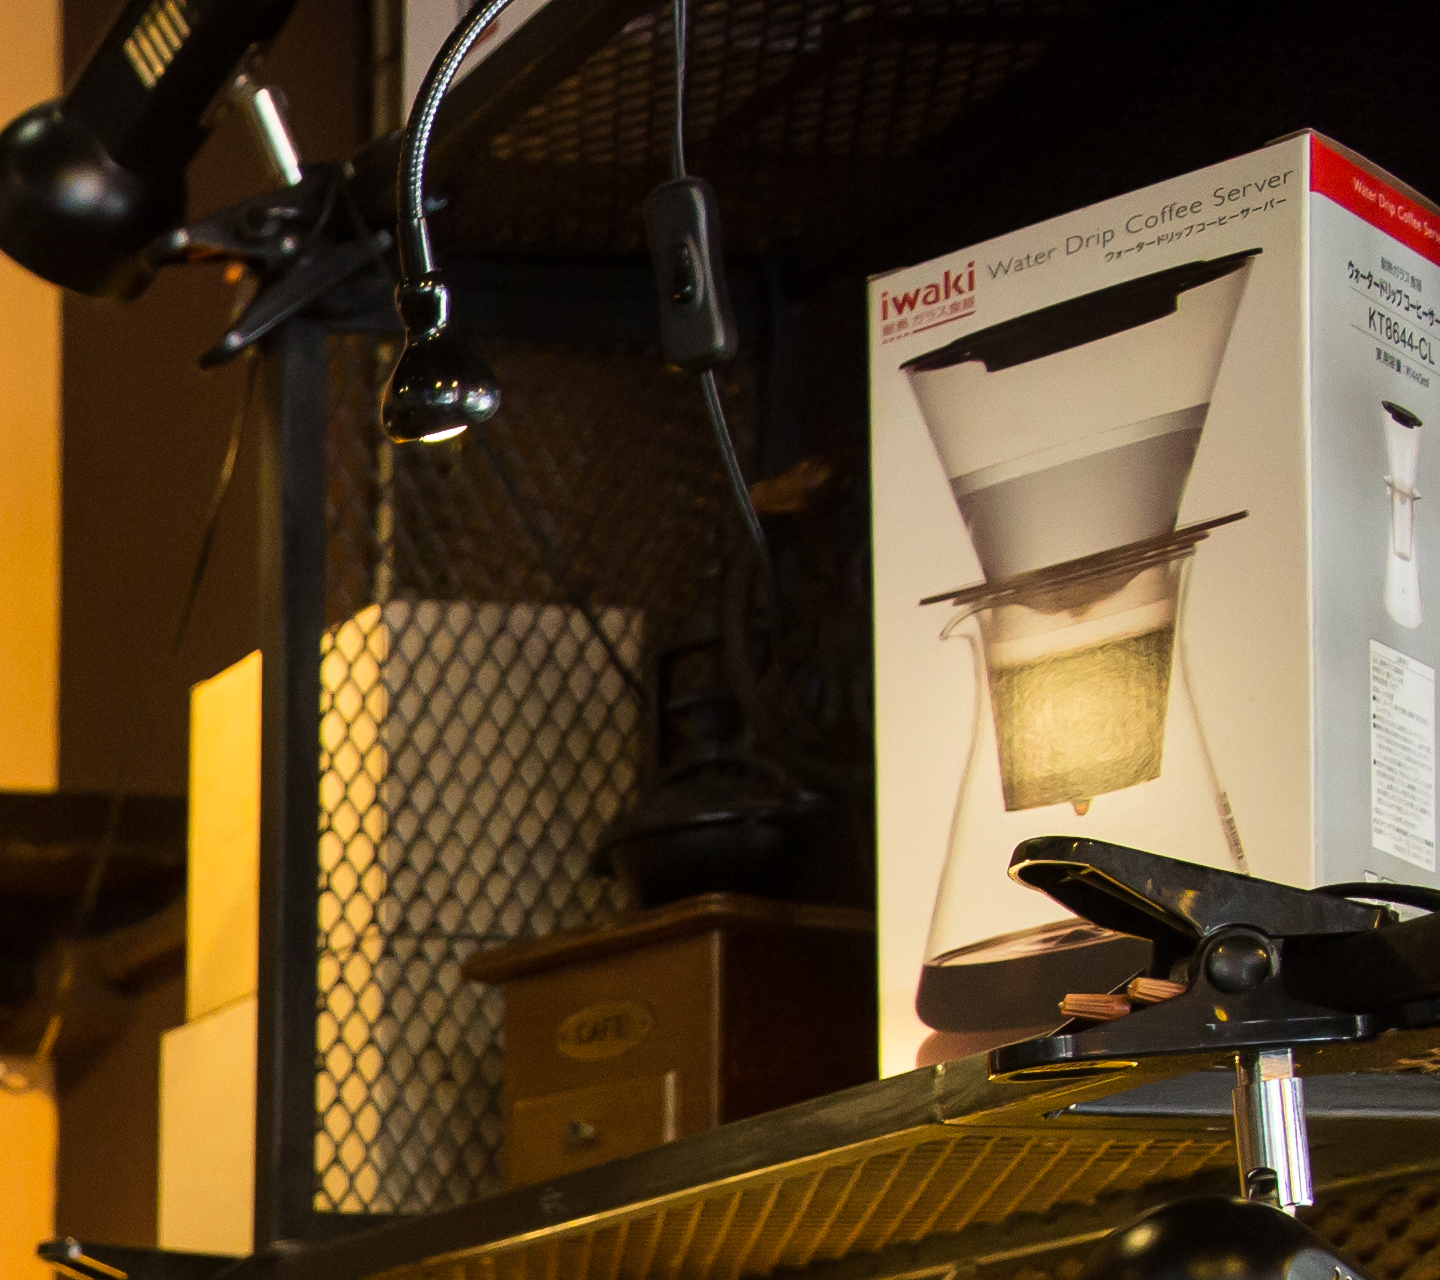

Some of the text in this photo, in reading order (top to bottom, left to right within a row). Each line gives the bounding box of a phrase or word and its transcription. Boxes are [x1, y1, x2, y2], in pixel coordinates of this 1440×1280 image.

[988, 169, 1294, 280] Water Drip Coffee Server
[881, 260, 975, 321] iwaki
[1368, 306, 1435, 366] KT8644-CL
